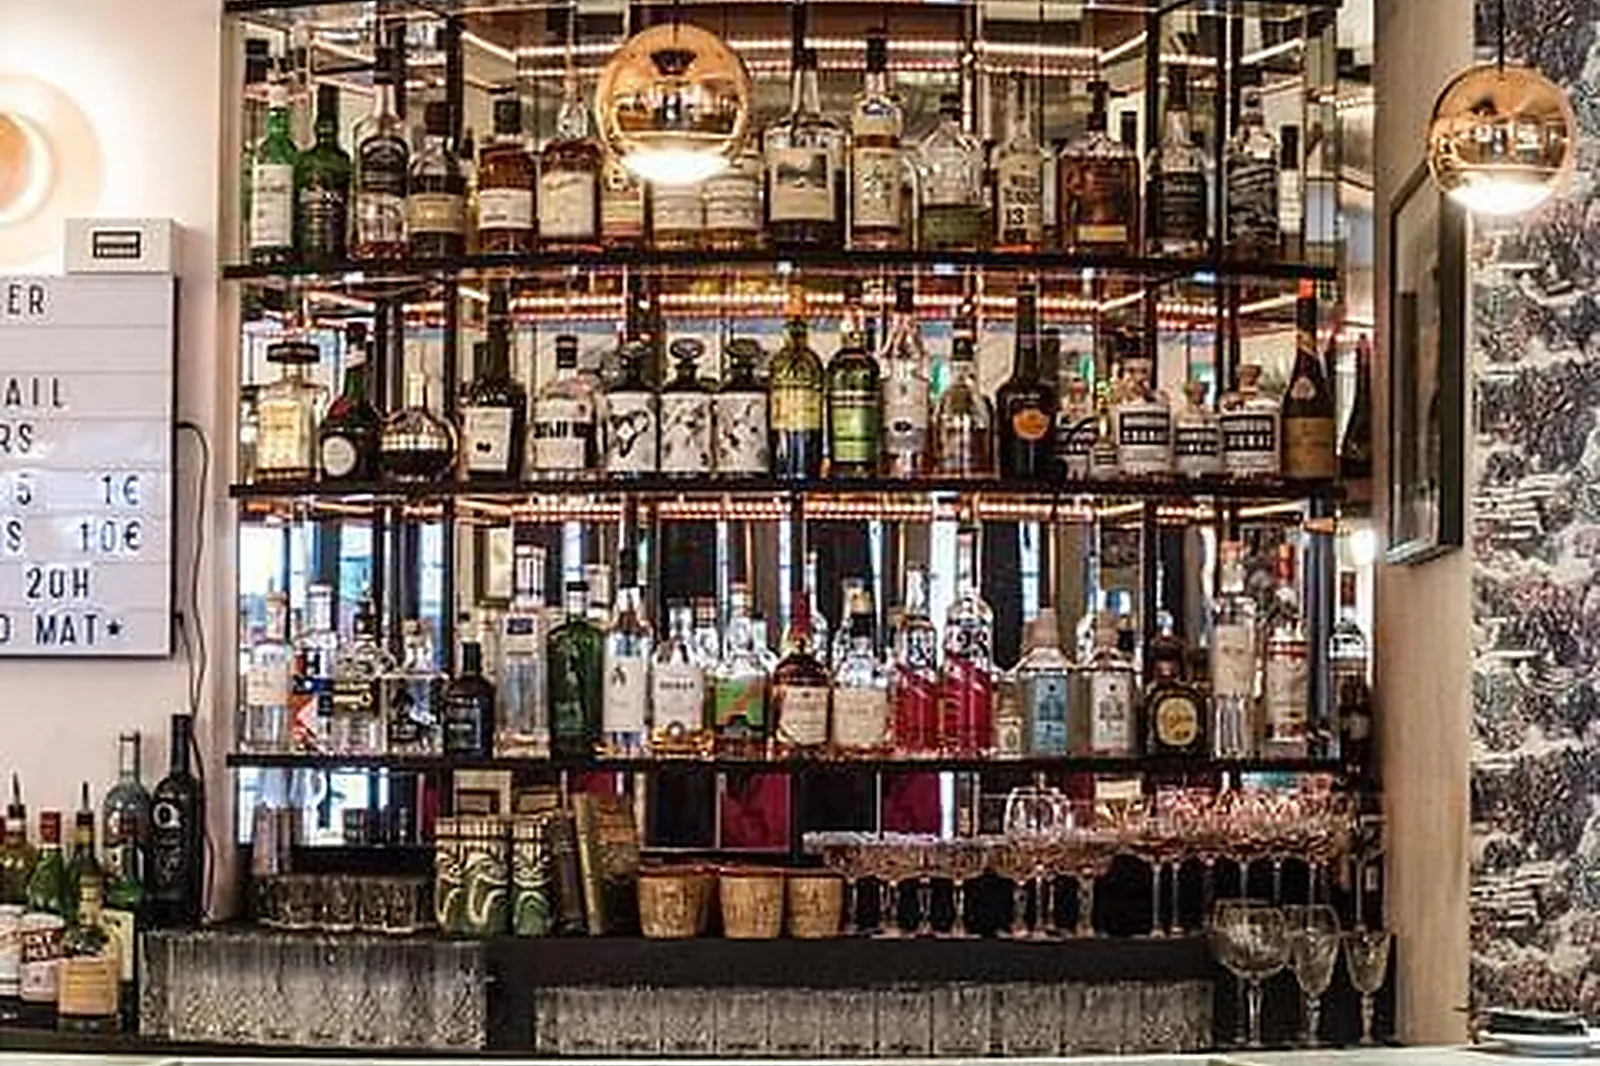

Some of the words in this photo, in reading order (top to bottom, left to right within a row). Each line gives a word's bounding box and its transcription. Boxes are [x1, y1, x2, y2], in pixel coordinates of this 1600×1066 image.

[8, 283, 45, 315] ER
[5, 377, 64, 409] AIL
[101, 474, 140, 506] 1€
[80, 520, 142, 552] 10€
[26, 566, 90, 599] 20H
[36, 613, 98, 645] MAT
